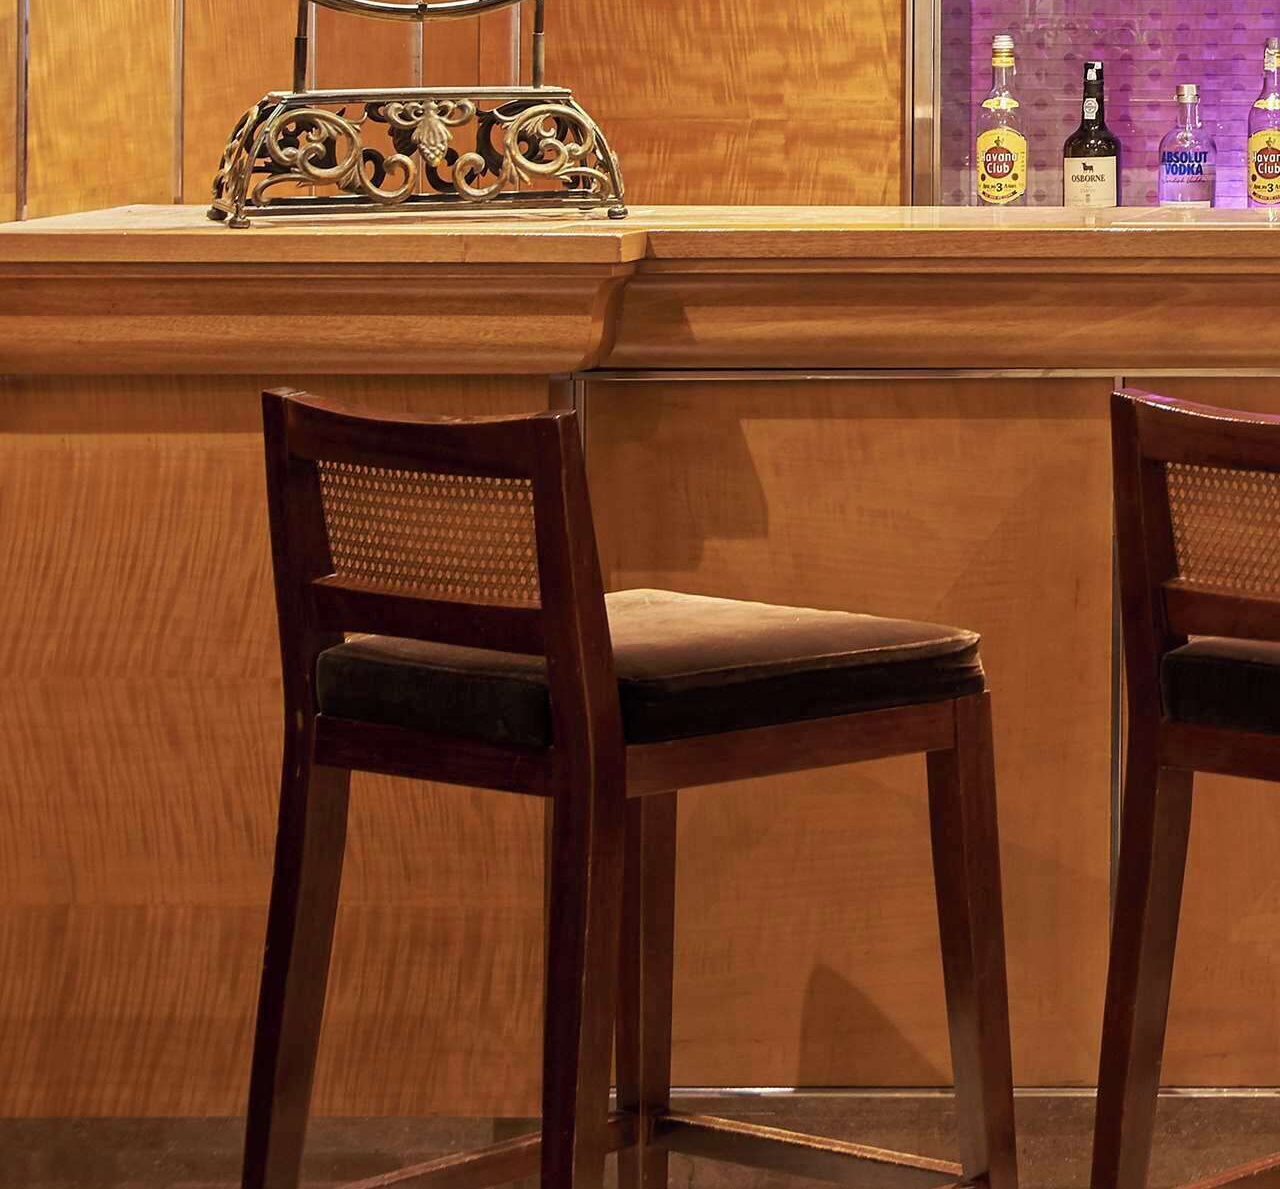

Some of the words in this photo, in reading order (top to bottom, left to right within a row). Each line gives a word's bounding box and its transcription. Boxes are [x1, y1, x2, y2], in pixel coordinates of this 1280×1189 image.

[982, 150, 1018, 162] Havana
[1162, 151, 1209, 163] ABSOLUT
[986, 162, 1010, 174] Club
[1165, 164, 1204, 175] VODKA
[1258, 162, 1280, 174] Club
[1071, 174, 1106, 183] OSBORNE
[996, 182, 1003, 192] 3
[1267, 183, 1274, 193] 3
